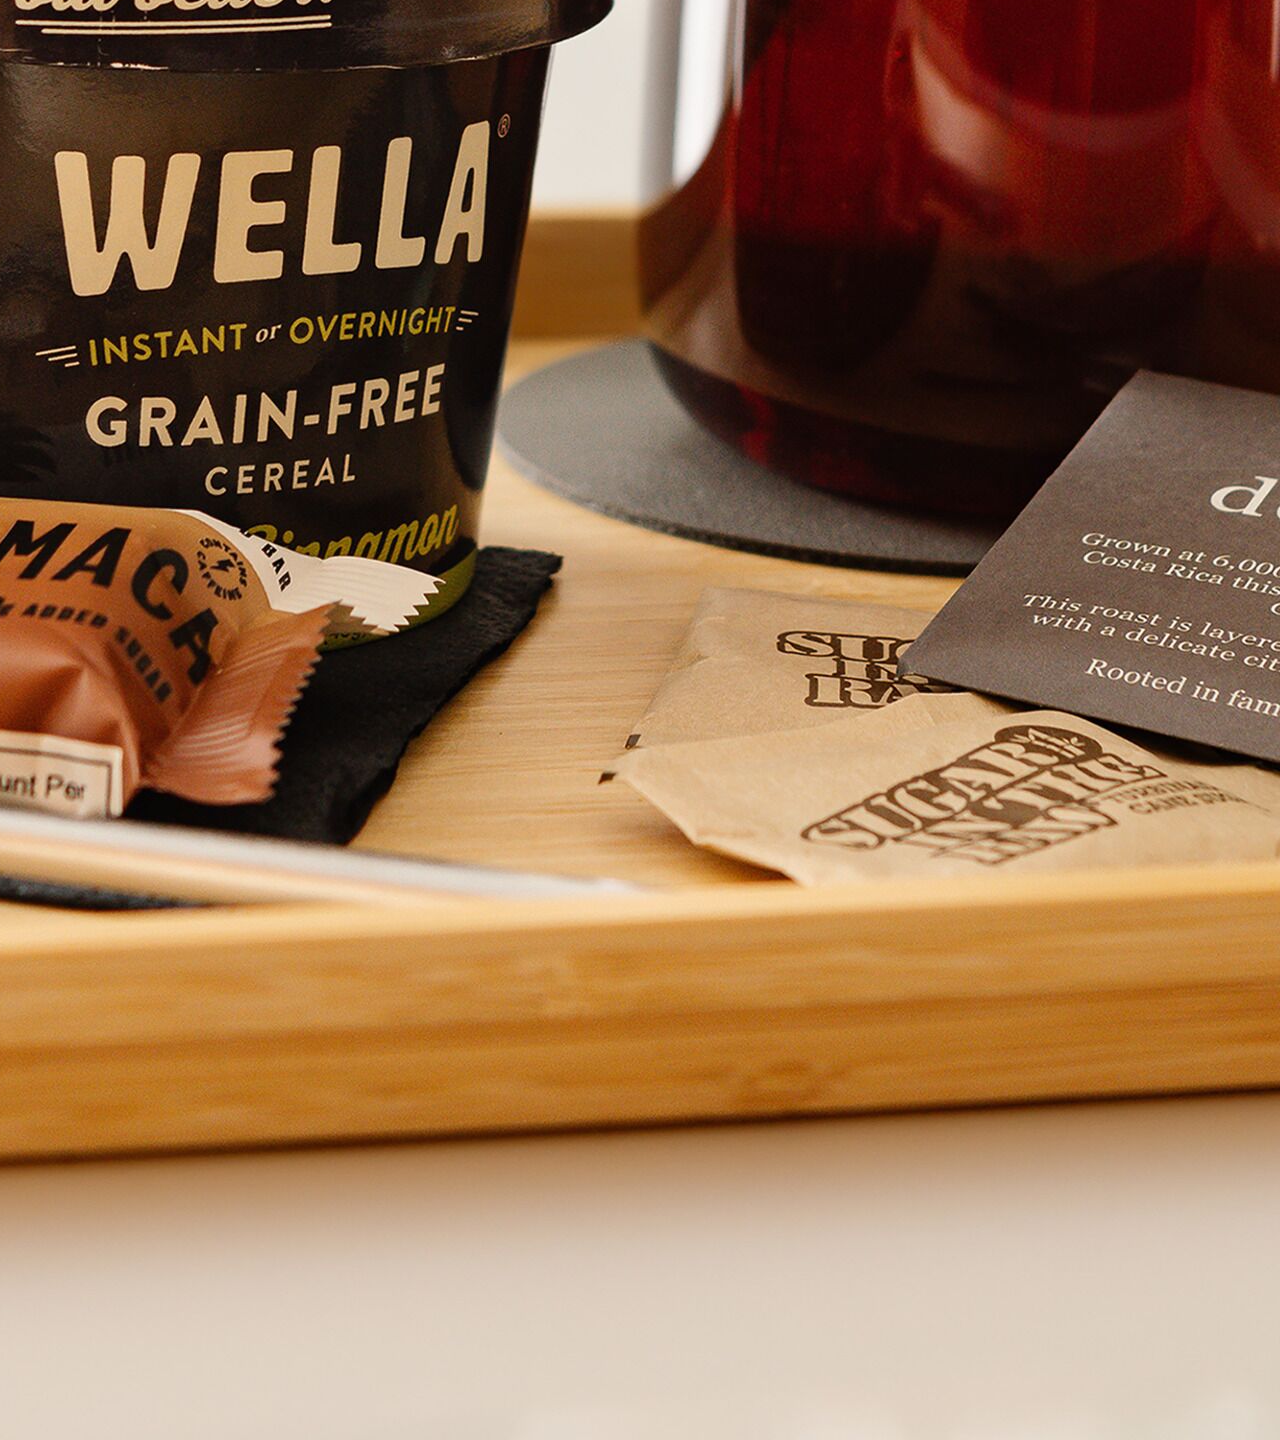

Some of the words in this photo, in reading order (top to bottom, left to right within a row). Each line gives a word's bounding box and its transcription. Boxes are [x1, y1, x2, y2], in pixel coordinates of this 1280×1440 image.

[53, 119, 491, 297] WELLA
[88, 323, 248, 367] INSTANT
[254, 323, 282, 344] or
[289, 305, 456, 345] OVERNIGHT
[84, 362, 446, 448] GRAIN-FREE
[204, 453, 357, 498] CEREAL
[260, 542, 292, 592] BAR
[1081, 532, 1171, 558] Grown
[1178, 547, 1208, 564] at
[1082, 549, 1158, 574] Costa
[1164, 562, 1225, 586] Rica
[1022, 593, 1084, 614] This
[1088, 603, 1163, 628] roast
[1167, 615, 1194, 634] is
[1031, 612, 1093, 634] with
[1099, 623, 1117, 639] a
[1124, 626, 1237, 663] delicate
[1084, 657, 1189, 696] Rooted
[1190, 679, 1221, 704] in
[44, 772, 88, 802] Per
[800, 738, 1064, 850] SUGAR
